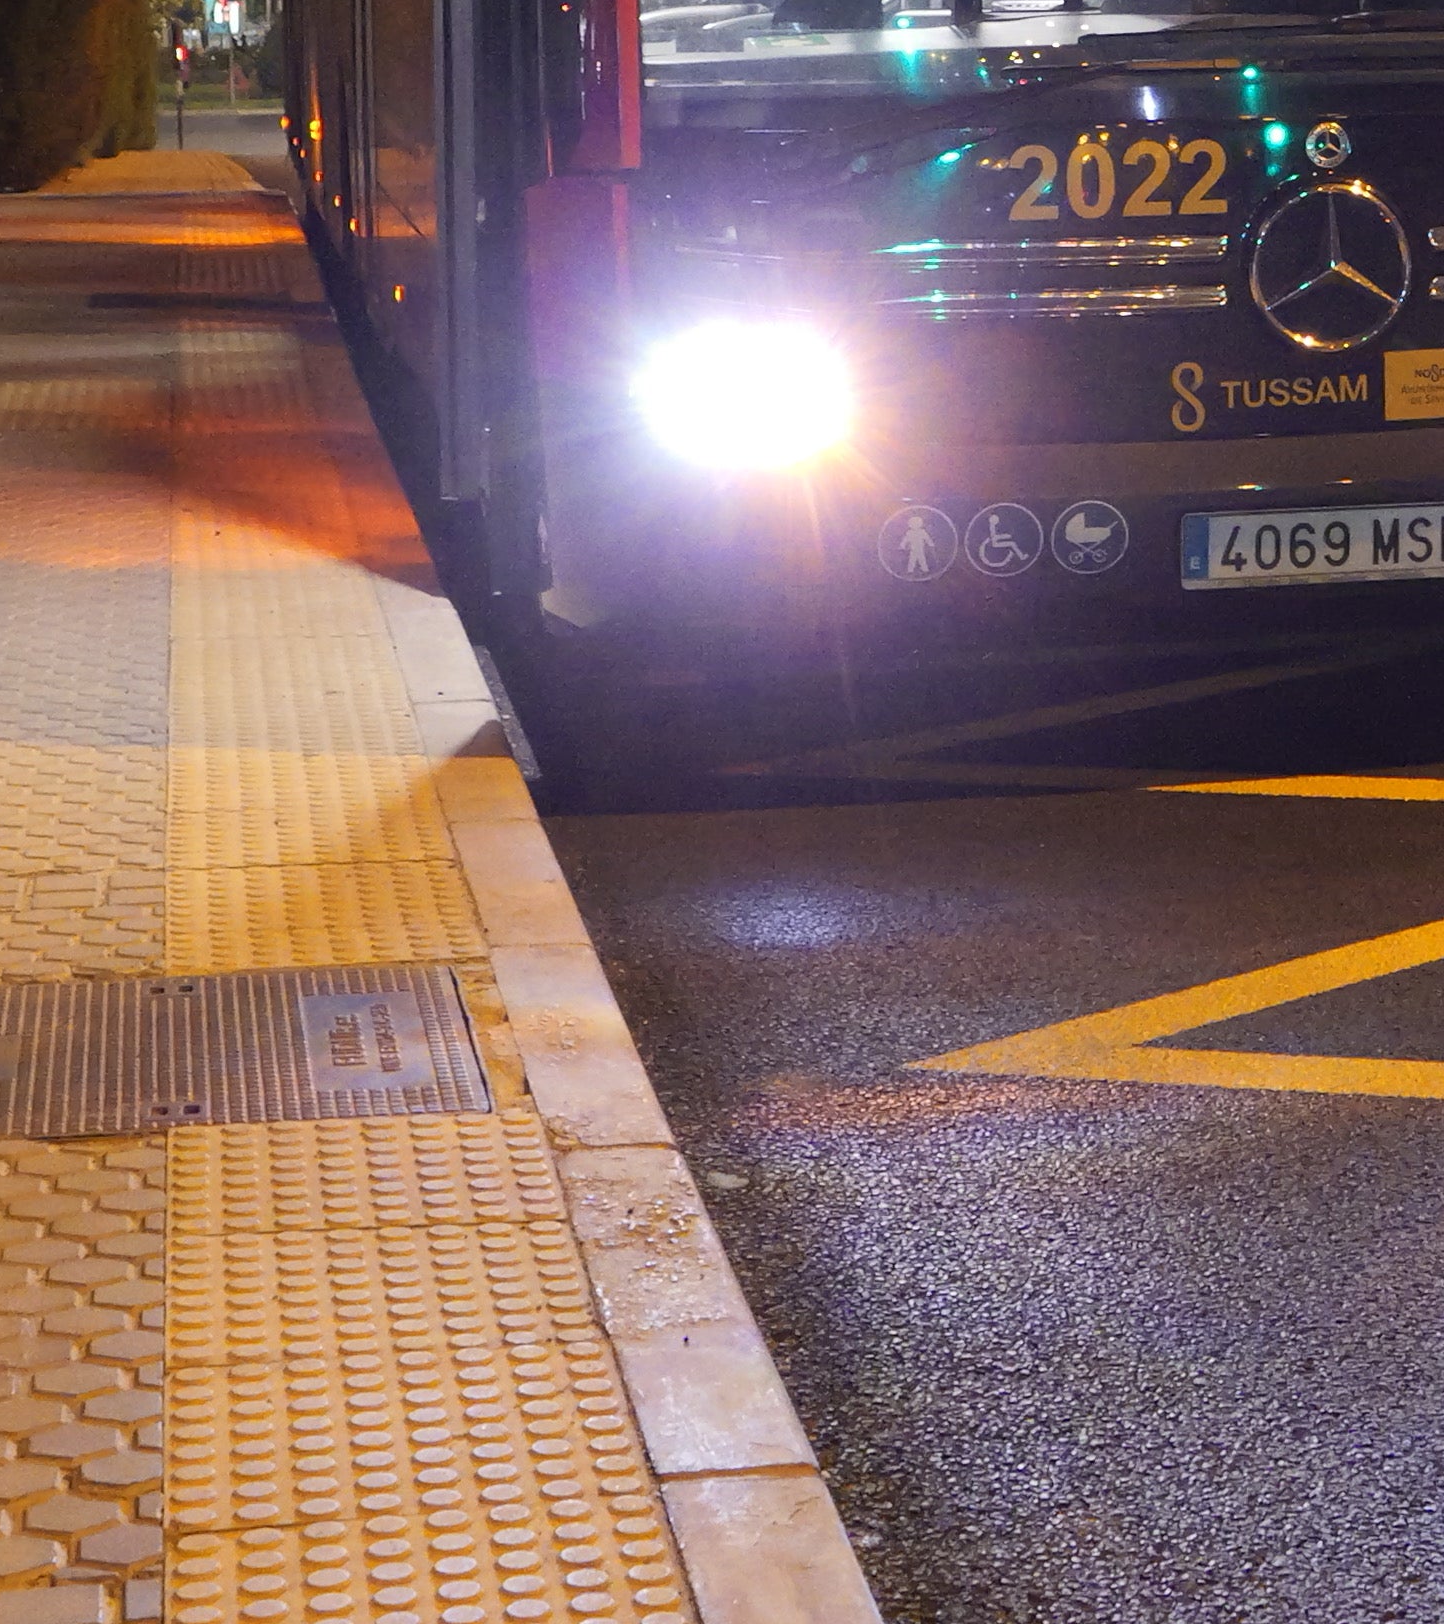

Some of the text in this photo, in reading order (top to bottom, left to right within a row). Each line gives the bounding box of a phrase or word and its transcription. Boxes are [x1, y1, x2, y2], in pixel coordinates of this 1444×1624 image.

[1009, 139, 1228, 220] 2022
[1221, 374, 1368, 409] TUSSAM
[1221, 522, 1350, 571] 4069
